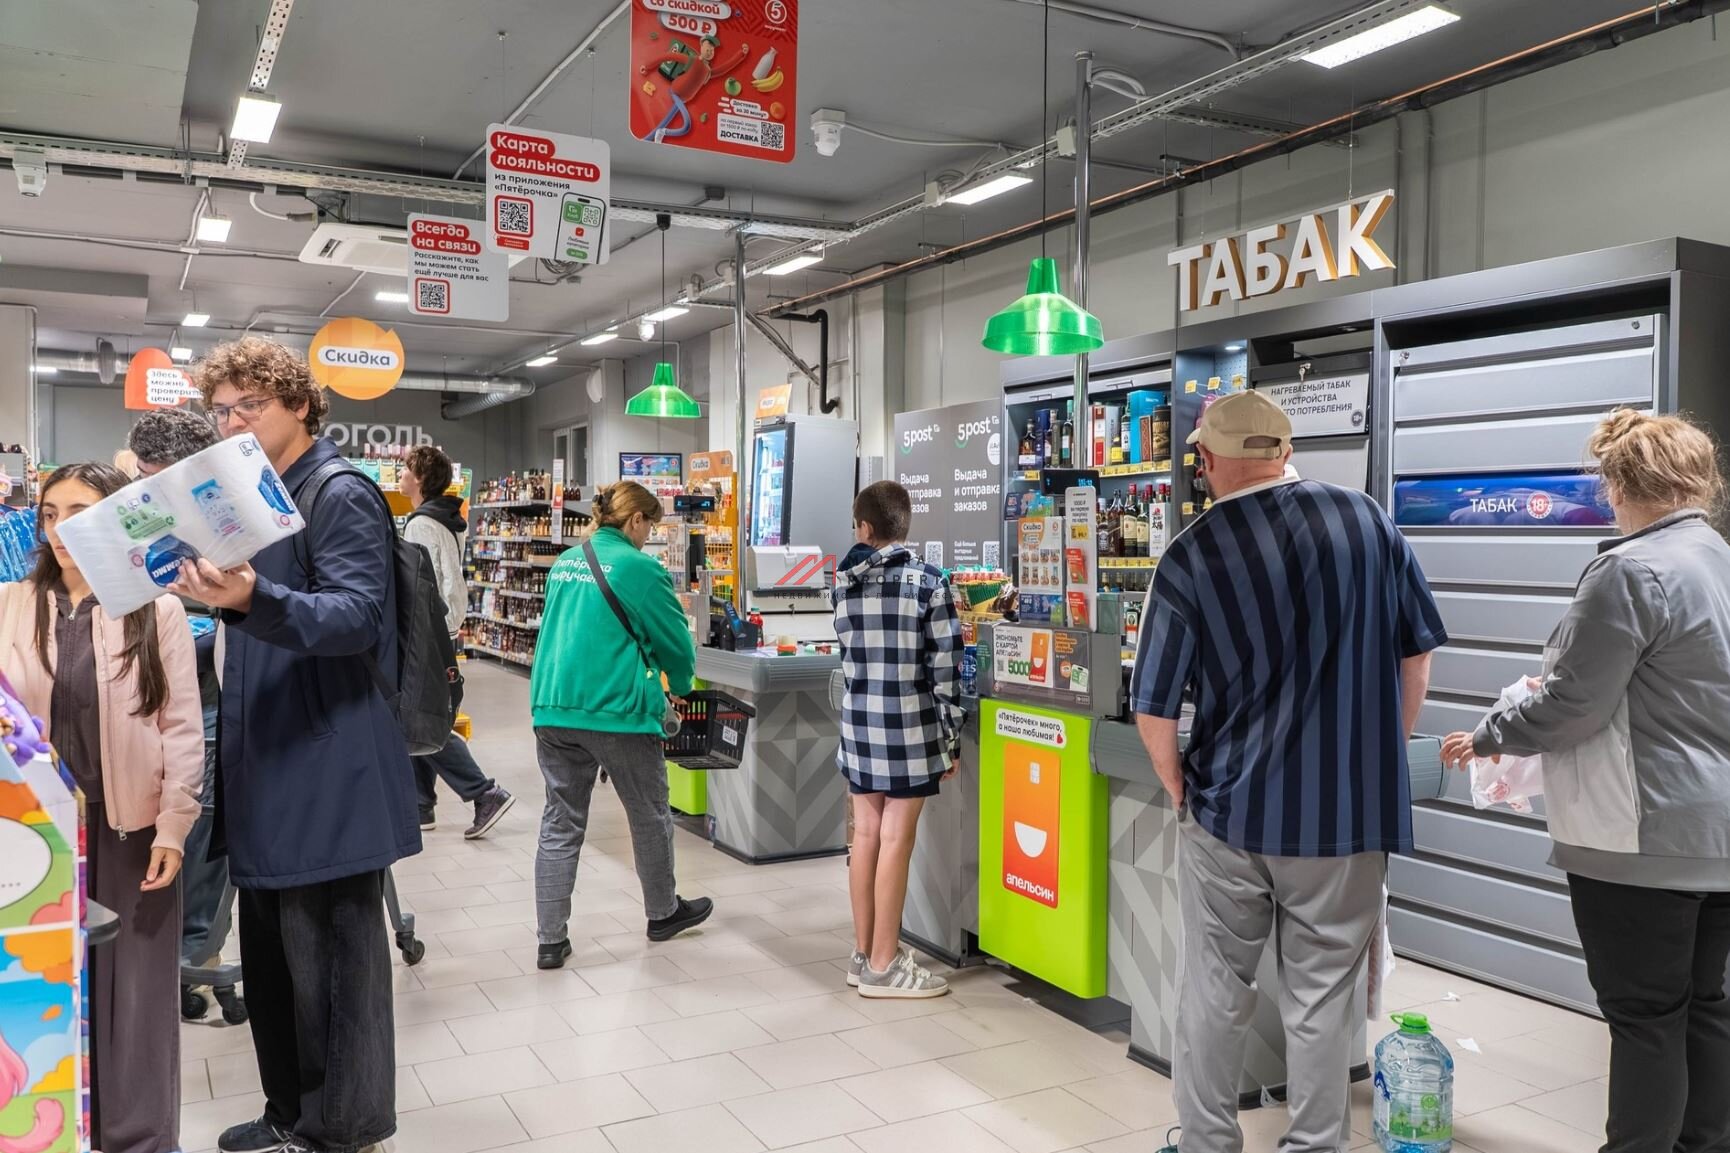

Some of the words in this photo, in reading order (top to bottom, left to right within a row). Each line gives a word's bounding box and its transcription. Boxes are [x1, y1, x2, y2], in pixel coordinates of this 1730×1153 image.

[668, 0, 720, 15] скидкой
[669, 14, 698, 31] 500
[497, 134, 548, 154] Карта
[721, 130, 759, 143] ДОСТАВКА
[496, 154, 594, 178] лояльности
[509, 175, 570, 190] приложения
[495, 183, 558, 198] «Пятёрочка»
[416, 221, 465, 237] Всегда
[416, 237, 434, 247] на
[438, 240, 476, 252] связи
[414, 251, 463, 263] Расскажите,
[1168, 193, 1396, 312] ТАБАК
[428, 262, 457, 270] можем
[433, 270, 458, 278] лучше
[325, 349, 391, 366] Скидка
[1271, 381, 1325, 396] НАГРЕВАЕМЫЙ
[1327, 380, 1351, 390] ТАБАК
[1288, 393, 1337, 405] УСТРОЙСТВА
[1297, 403, 1352, 415] ПОТРЕБЛЕНИЯ
[324, 423, 433, 448] ОГОЛЬ
[958, 416, 991, 440] 5post
[904, 425, 933, 447] 5post
[900, 473, 929, 485] Выдача
[954, 469, 987, 481] Выдача
[954, 487, 959, 496] и
[912, 503, 929, 513] азов
[954, 501, 988, 512] заказов
[1470, 499, 1517, 513] ТАБАК
[999, 712, 1038, 726] «Пятёрочек»
[1040, 722, 1062, 733] много,
[1004, 725, 1021, 734] наша
[1022, 729, 1055, 741] любимая!
[1007, 873, 1054, 902] апельсин
